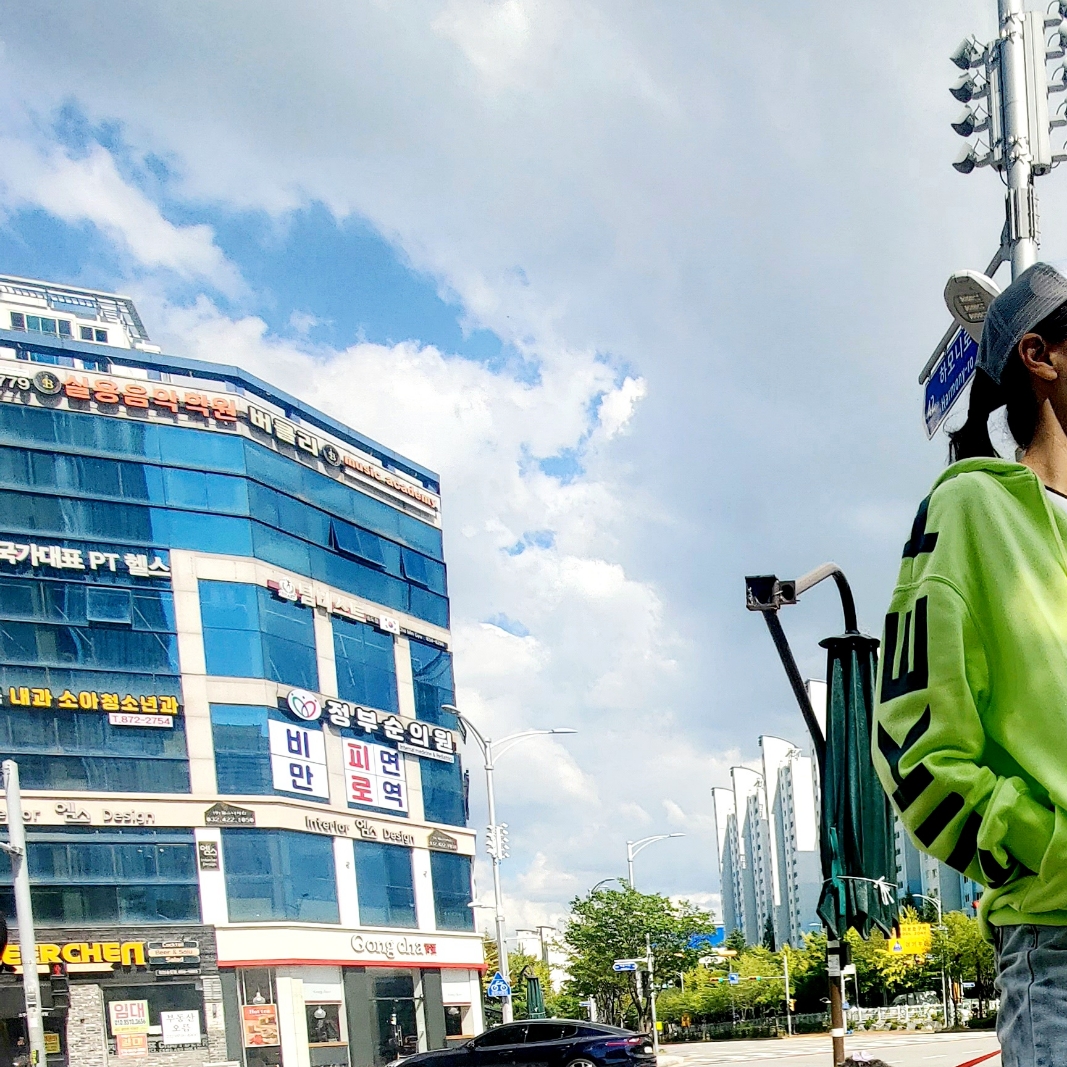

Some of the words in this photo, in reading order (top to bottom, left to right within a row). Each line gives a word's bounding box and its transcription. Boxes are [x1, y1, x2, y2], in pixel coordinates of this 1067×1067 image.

[63, 375, 237, 422] 실용음악학원
[249, 405, 319, 457] 버클리
[343, 455, 384, 482] music
[385, 473, 439, 508] academy
[0, 541, 86, 570] 국가대표
[88, 551, 120, 572] PT
[123, 553, 171, 577] 헬스
[9, 686, 52, 707] 내과
[58, 690, 179, 715] 소아청소년과
[112, 715, 171, 726] T.872-2754
[326, 699, 453, 754] 정부순의원
[286, 728, 314, 792] 비만
[347, 742, 373, 803] 피로
[380, 749, 403, 808] 면역
[103, 809, 156, 825] Design
[305, 816, 349, 835] Interior
[383, 828, 415, 846] Design
[351, 935, 394, 958] Gong
[397, 937, 424, 955] cha
[114, 1003, 145, 1019] 임대
[166, 1013, 195, 1023] 부동산
